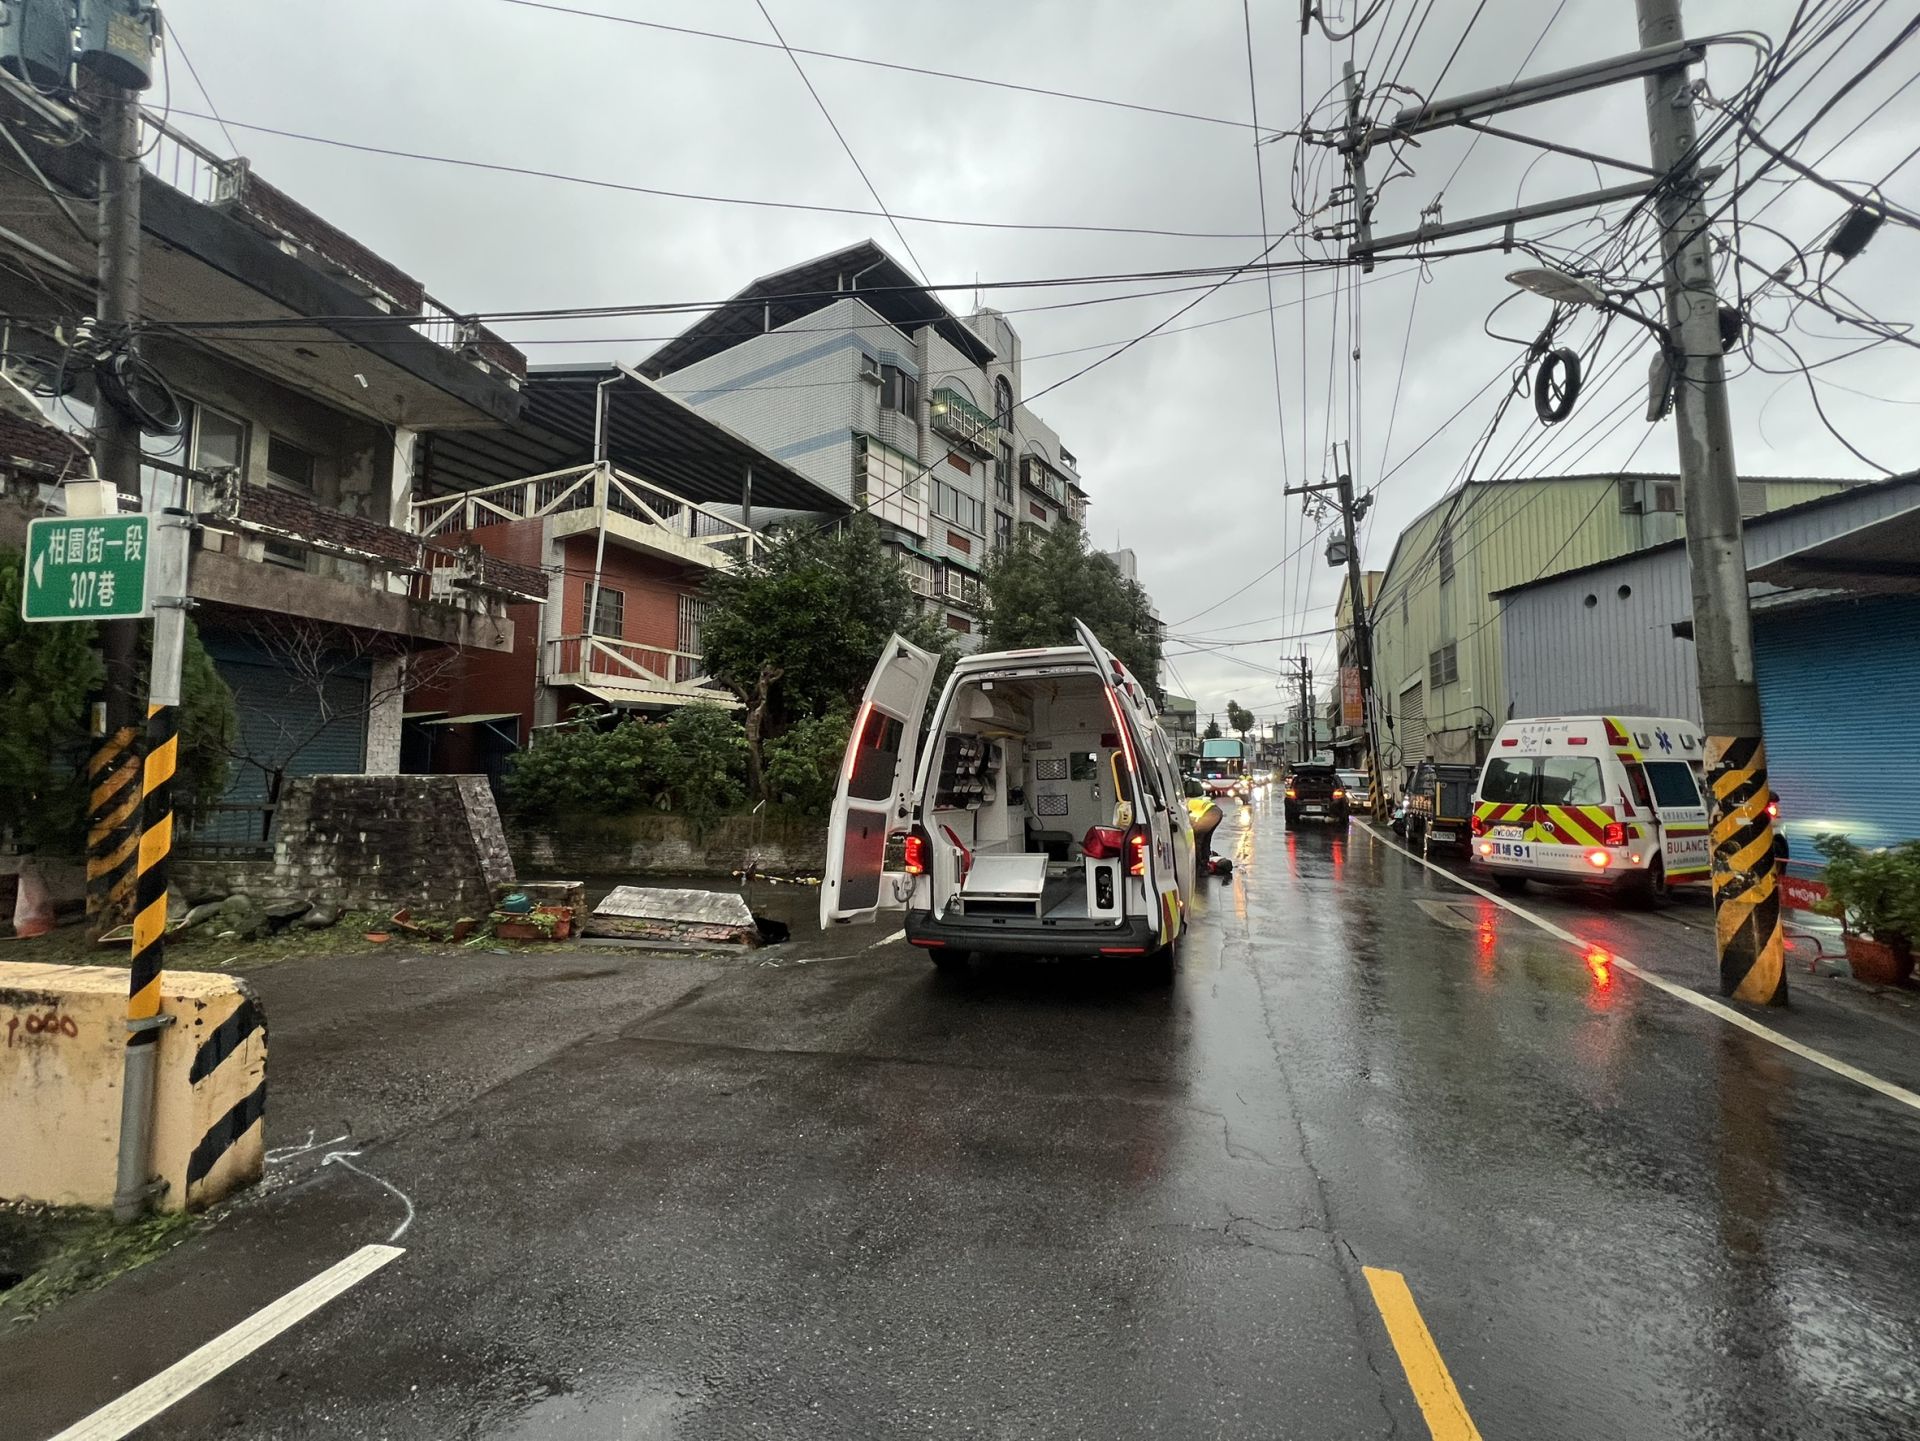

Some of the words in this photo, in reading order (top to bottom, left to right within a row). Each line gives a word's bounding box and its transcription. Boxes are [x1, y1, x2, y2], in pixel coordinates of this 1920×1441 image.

[49, 524, 143, 565] 柑園街一段
[69, 570, 116, 609] 307巷
